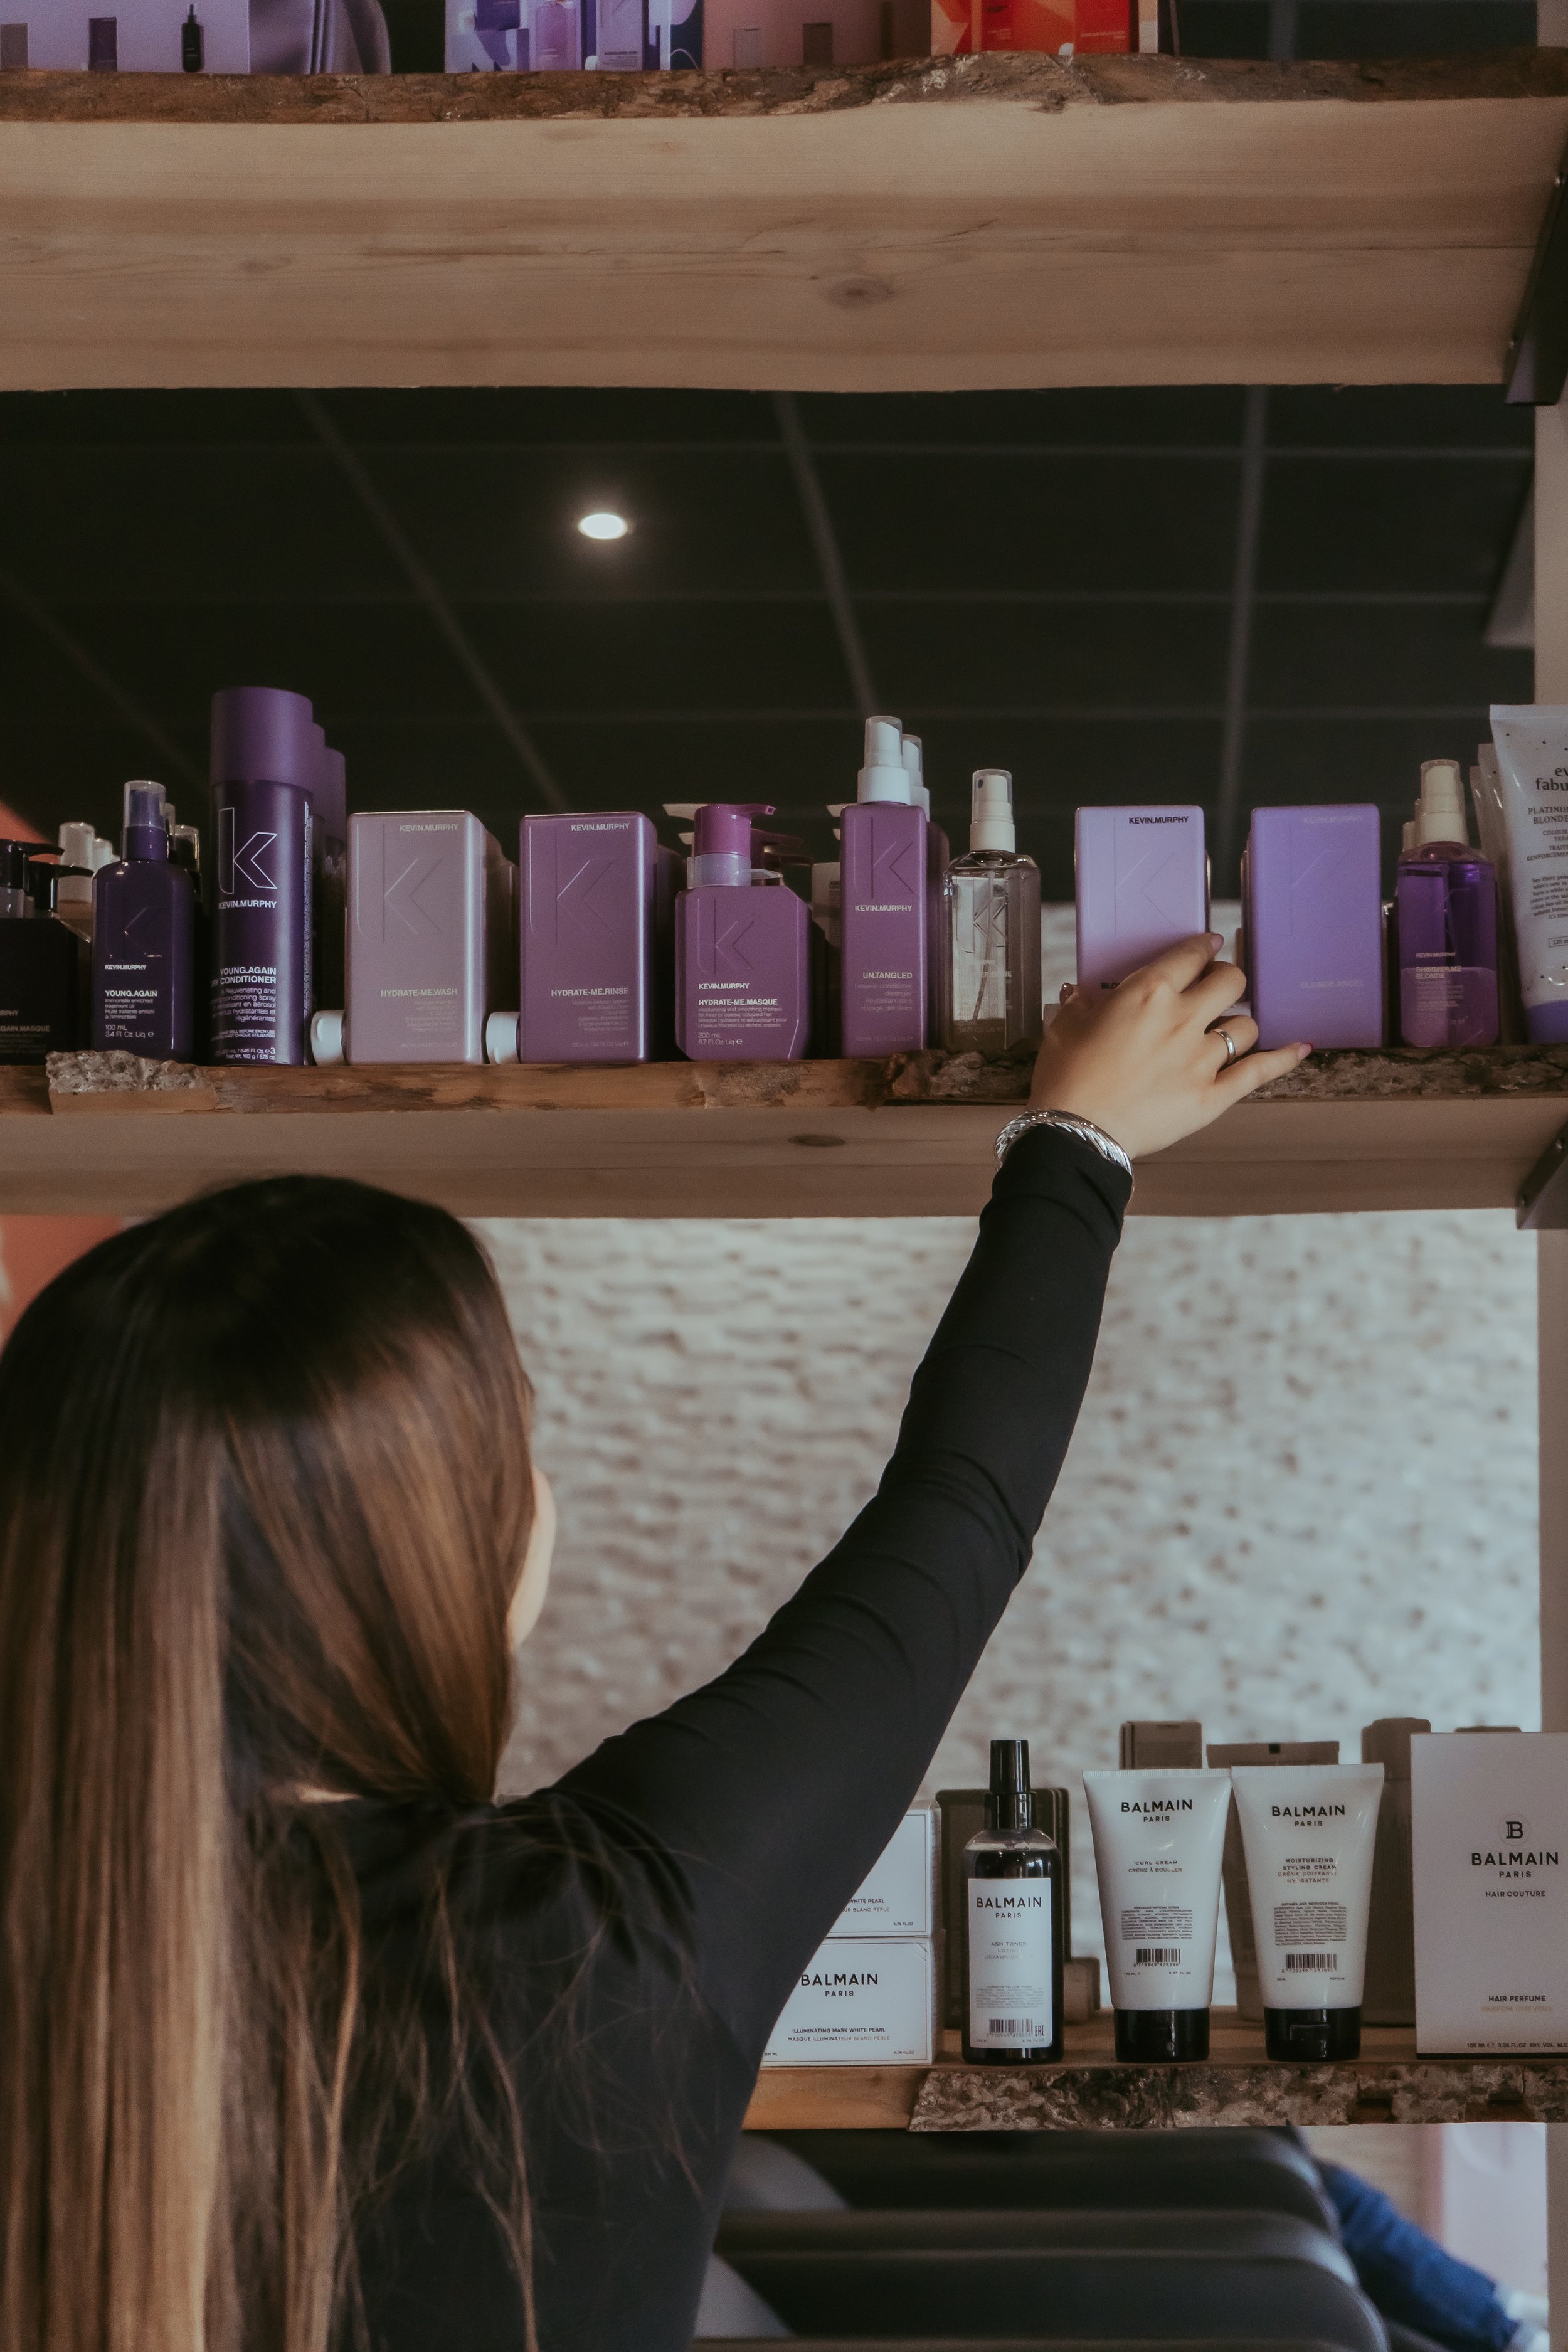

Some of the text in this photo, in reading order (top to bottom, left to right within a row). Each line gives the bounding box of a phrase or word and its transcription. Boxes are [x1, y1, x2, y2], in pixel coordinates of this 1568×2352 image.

[1129, 816, 1189, 824] KEVIN.MURPHY
[400, 823, 460, 832] KEVIN.MURPHY
[571, 822, 630, 832] KEVIN.MURPHY
[218, 899, 277, 909] KEVIN.MURPHY
[220, 966, 276, 976] YOUNG.AGAIN
[220, 975, 276, 985] CONDITIONER
[380, 988, 458, 997] HYDRATE-ME.WASH
[551, 987, 629, 997] HYDRATE-ME.RINSE
[1121, 1799, 1192, 1813] BALMAIN
[1272, 1804, 1345, 1817] BALMAIN
[1471, 1851, 1559, 1866] BALMAIN
[977, 1897, 1042, 1908] BALMAIN
[800, 1974, 878, 1986] BALMAIN
